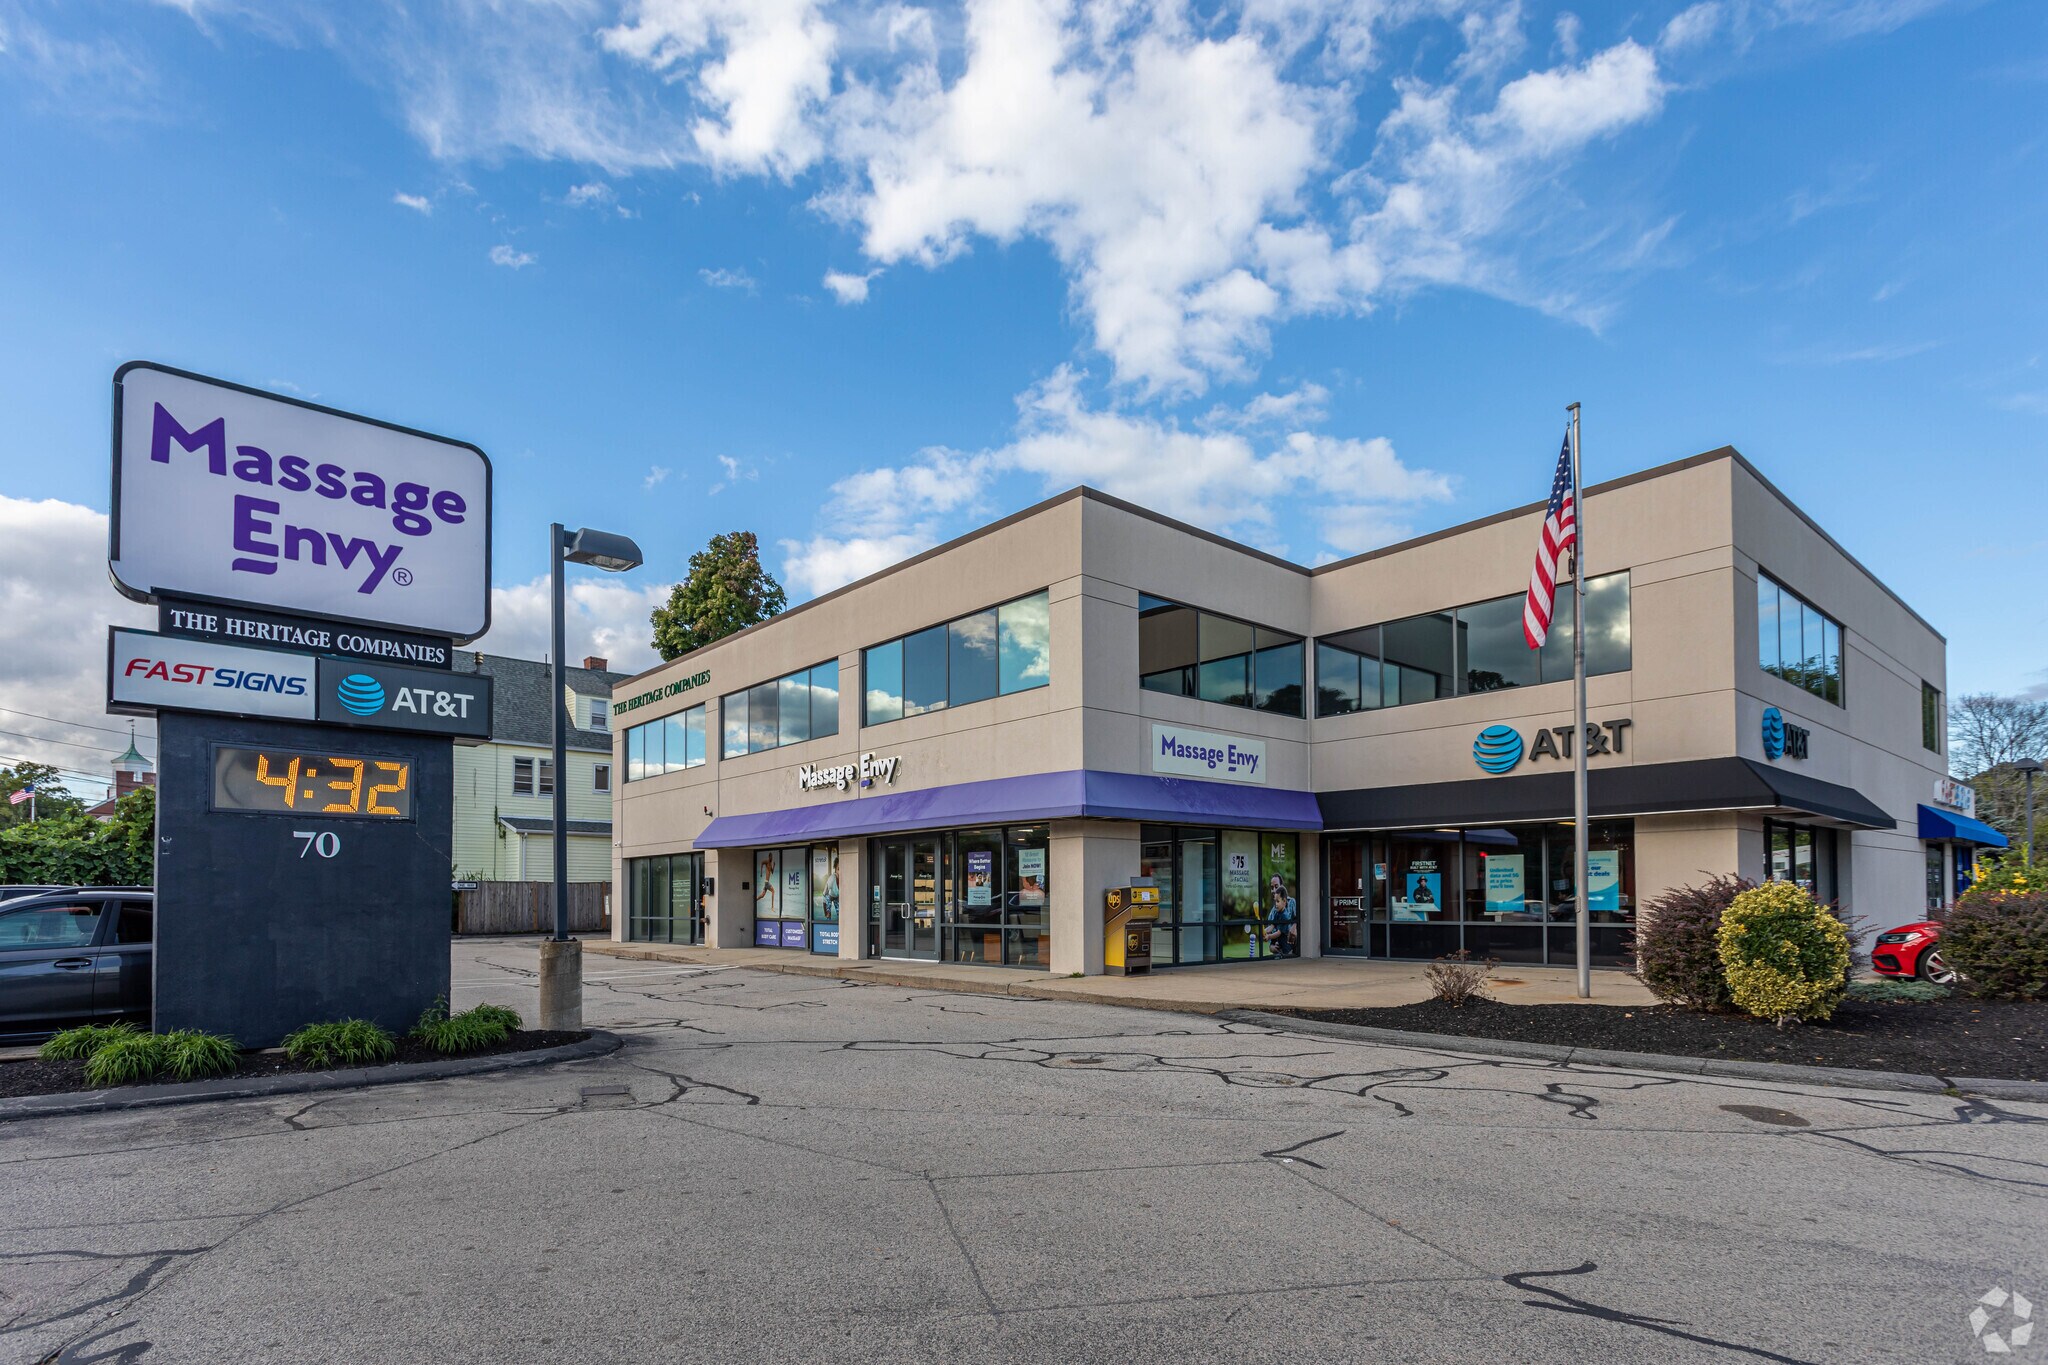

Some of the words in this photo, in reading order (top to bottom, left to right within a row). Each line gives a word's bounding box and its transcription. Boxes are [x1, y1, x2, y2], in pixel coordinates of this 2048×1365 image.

[151, 401, 466, 536] Massage
[170, 608, 218, 633] THE
[224, 617, 331, 648] HERITAGE
[336, 633, 446, 664] COMPANIES
[124, 658, 308, 696] FASTSIGNS
[612, 700, 627, 716] THE
[628, 688, 663, 712] HERITAGE
[664, 669, 711, 698] COMPANIES
[391, 687, 475, 719] AT&T
[1161, 734, 1224, 769] Massage
[1227, 744, 1259, 774] Envy
[1528, 718, 1632, 762] AT&T
[256, 754, 408, 815] 4:32
[799, 763, 857, 791] Massage
[860, 752, 901, 786] Envy
[293, 831, 341, 858] 70
[1338, 898, 1359, 906] PRIME
